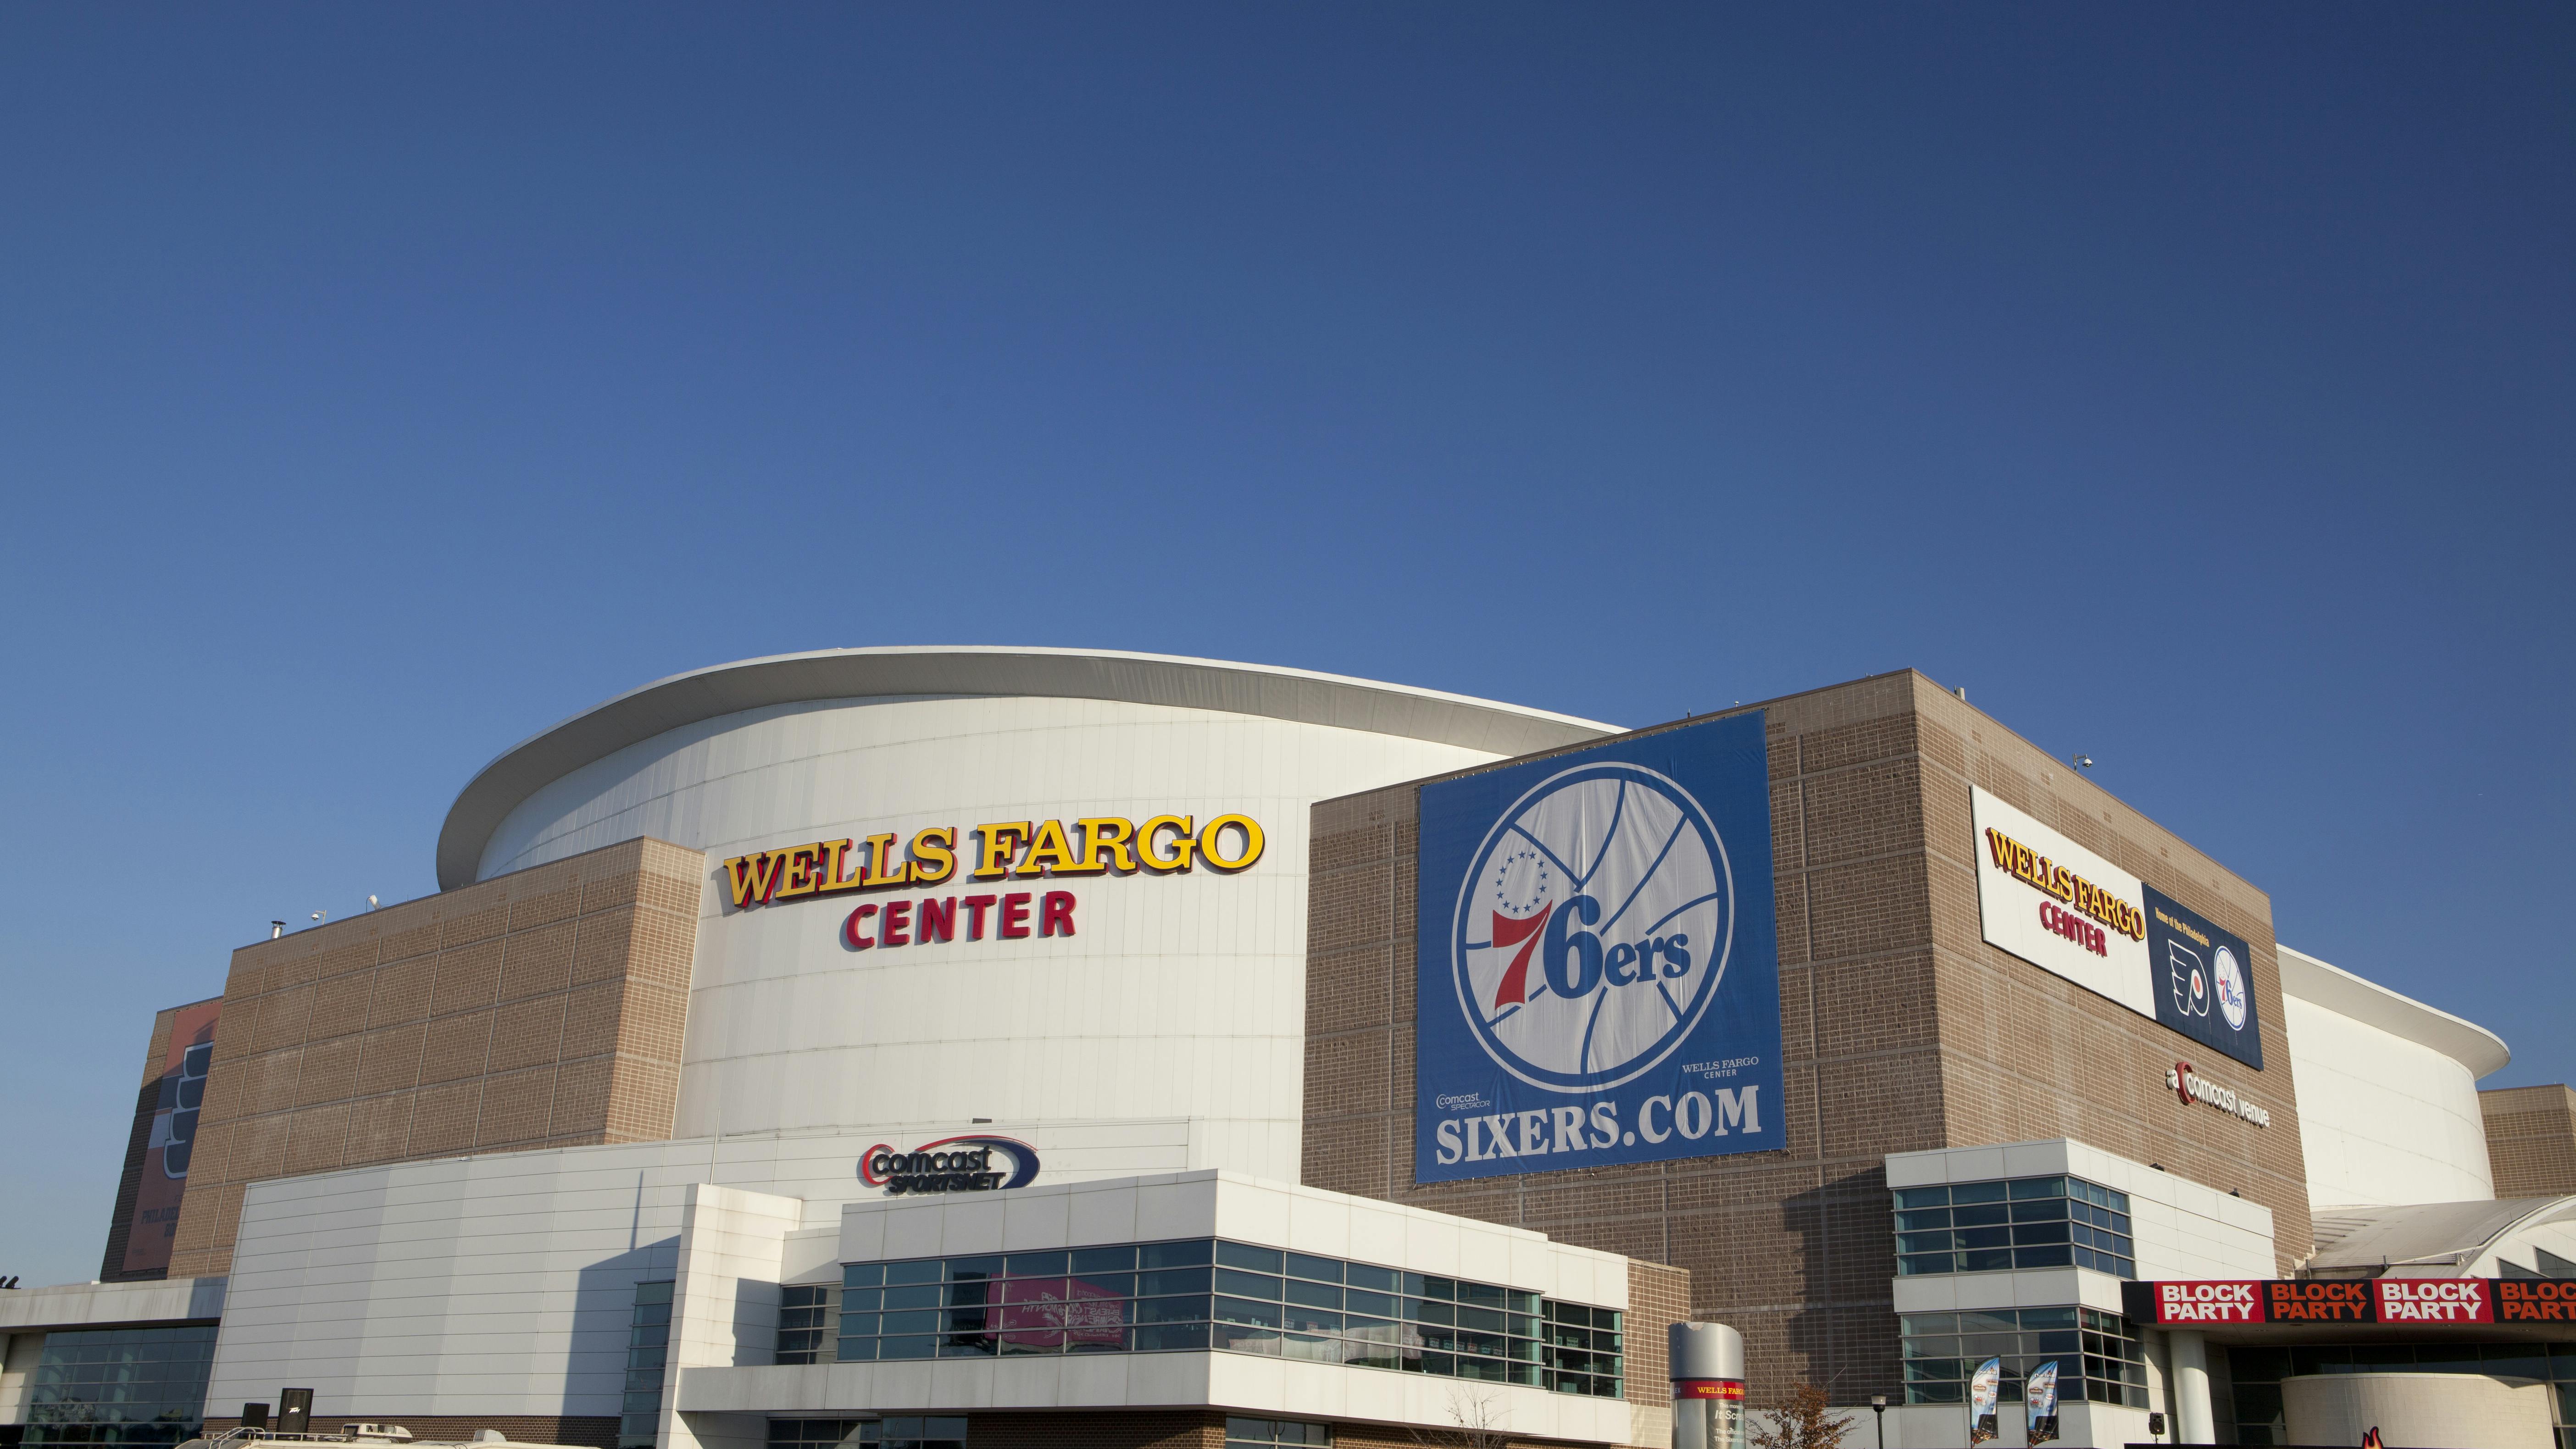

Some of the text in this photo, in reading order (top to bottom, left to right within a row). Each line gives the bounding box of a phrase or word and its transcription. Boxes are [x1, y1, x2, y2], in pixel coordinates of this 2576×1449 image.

[723, 814, 1266, 908] WELLS FARGO
[1985, 827, 2145, 942] WELLS FARGO
[846, 890, 1077, 948] CENTER
[2155, 907, 2210, 948] Home of the Philadelphia
[2039, 901, 2108, 957] CENTER
[1493, 899, 1691, 1010] 76ers
[2219, 976, 2242, 1010] 76ers
[1682, 1056, 1759, 1073] WELLS FARGO
[1704, 1069, 1737, 1079] CENTER
[1451, 1100, 1490, 1111] SPECTACOR
[2166, 1069, 2180, 1089] a
[2238, 1099, 2270, 1127] venue
[1436, 1085, 1761, 1166] SIXERS.COM
[888, 1172, 1006, 1193] SPORTSNET
[2162, 1284, 2254, 1302] BLOCK
[2271, 1283, 2367, 1300] BLOCK
[2382, 1283, 2482, 1300] BLOCK
[2164, 1302, 2254, 1320] PARTY
[2273, 1302, 2366, 1319] PARTY
[2384, 1302, 2482, 1319] PARTY
[1715, 1410, 1723, 1419] It
